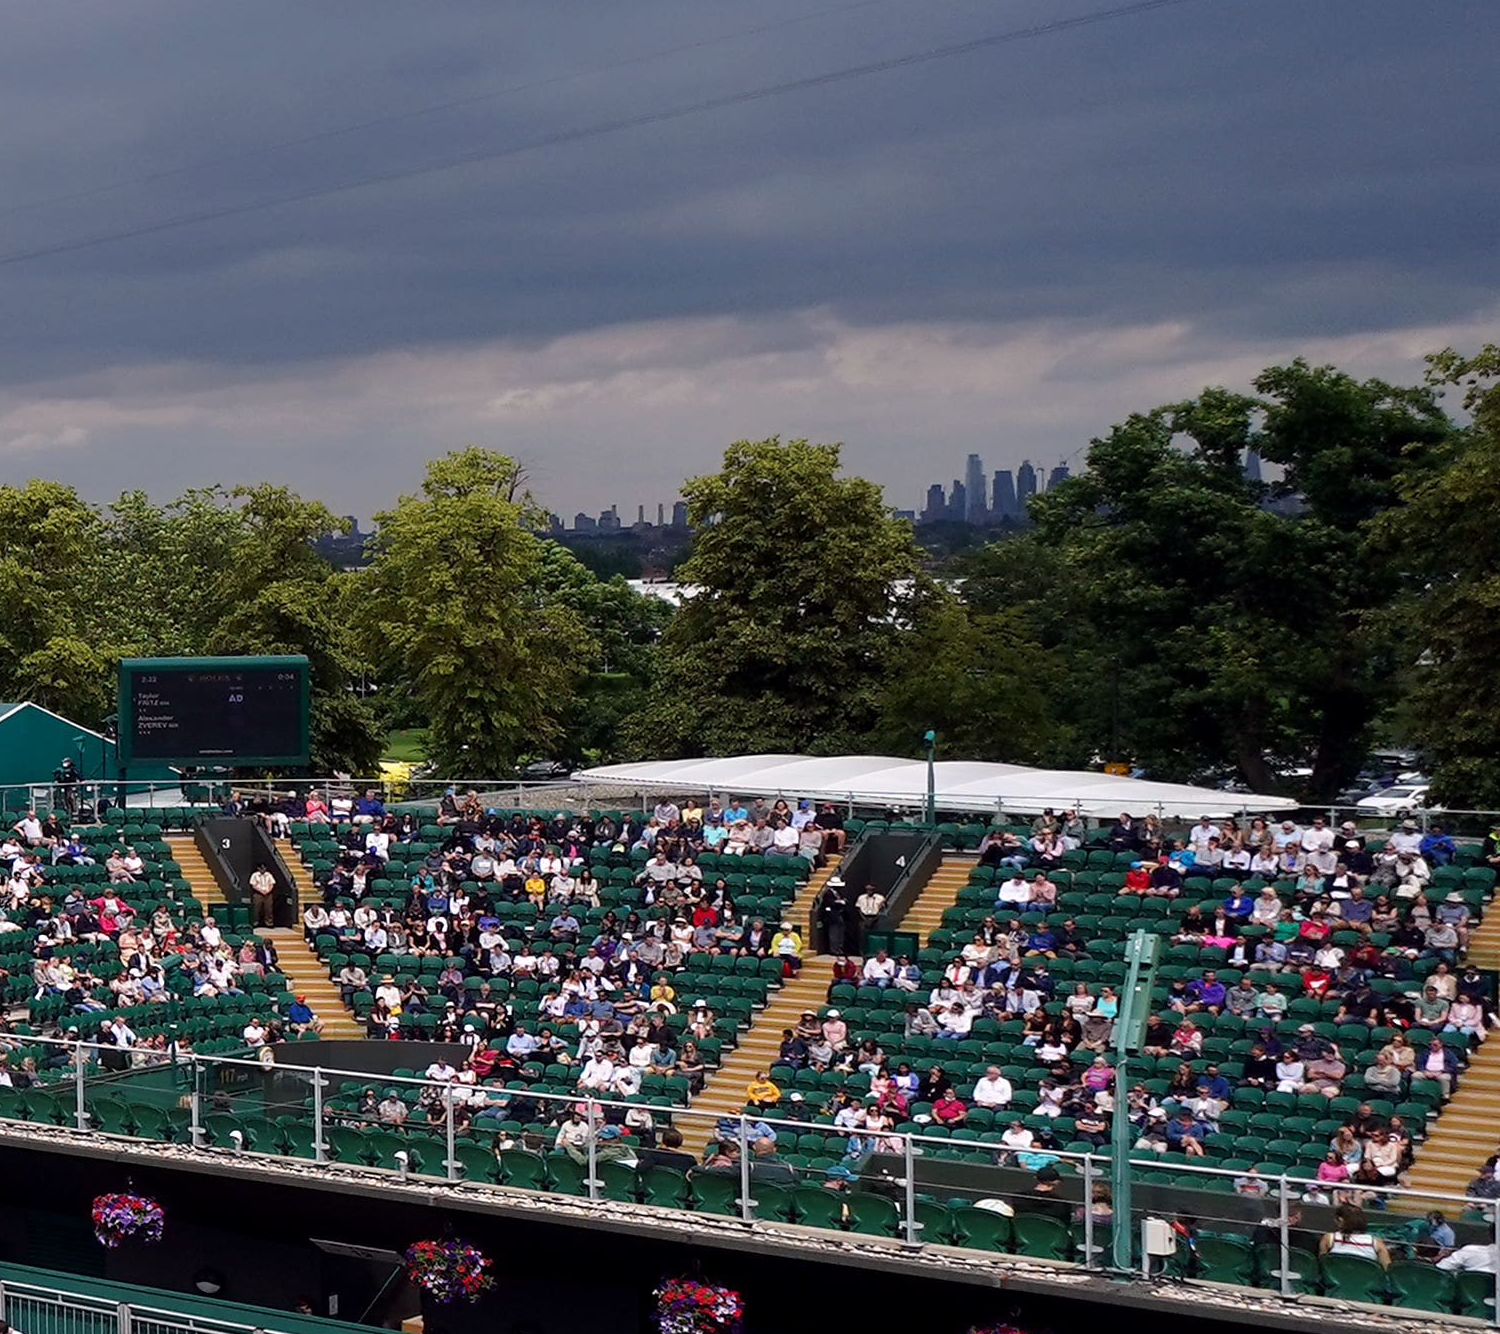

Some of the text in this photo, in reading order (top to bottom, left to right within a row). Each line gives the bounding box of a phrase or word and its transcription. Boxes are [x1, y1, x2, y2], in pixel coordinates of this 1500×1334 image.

[229, 694, 244, 703] AD
[222, 838, 231, 849] 3
[895, 855, 906, 868] 4
